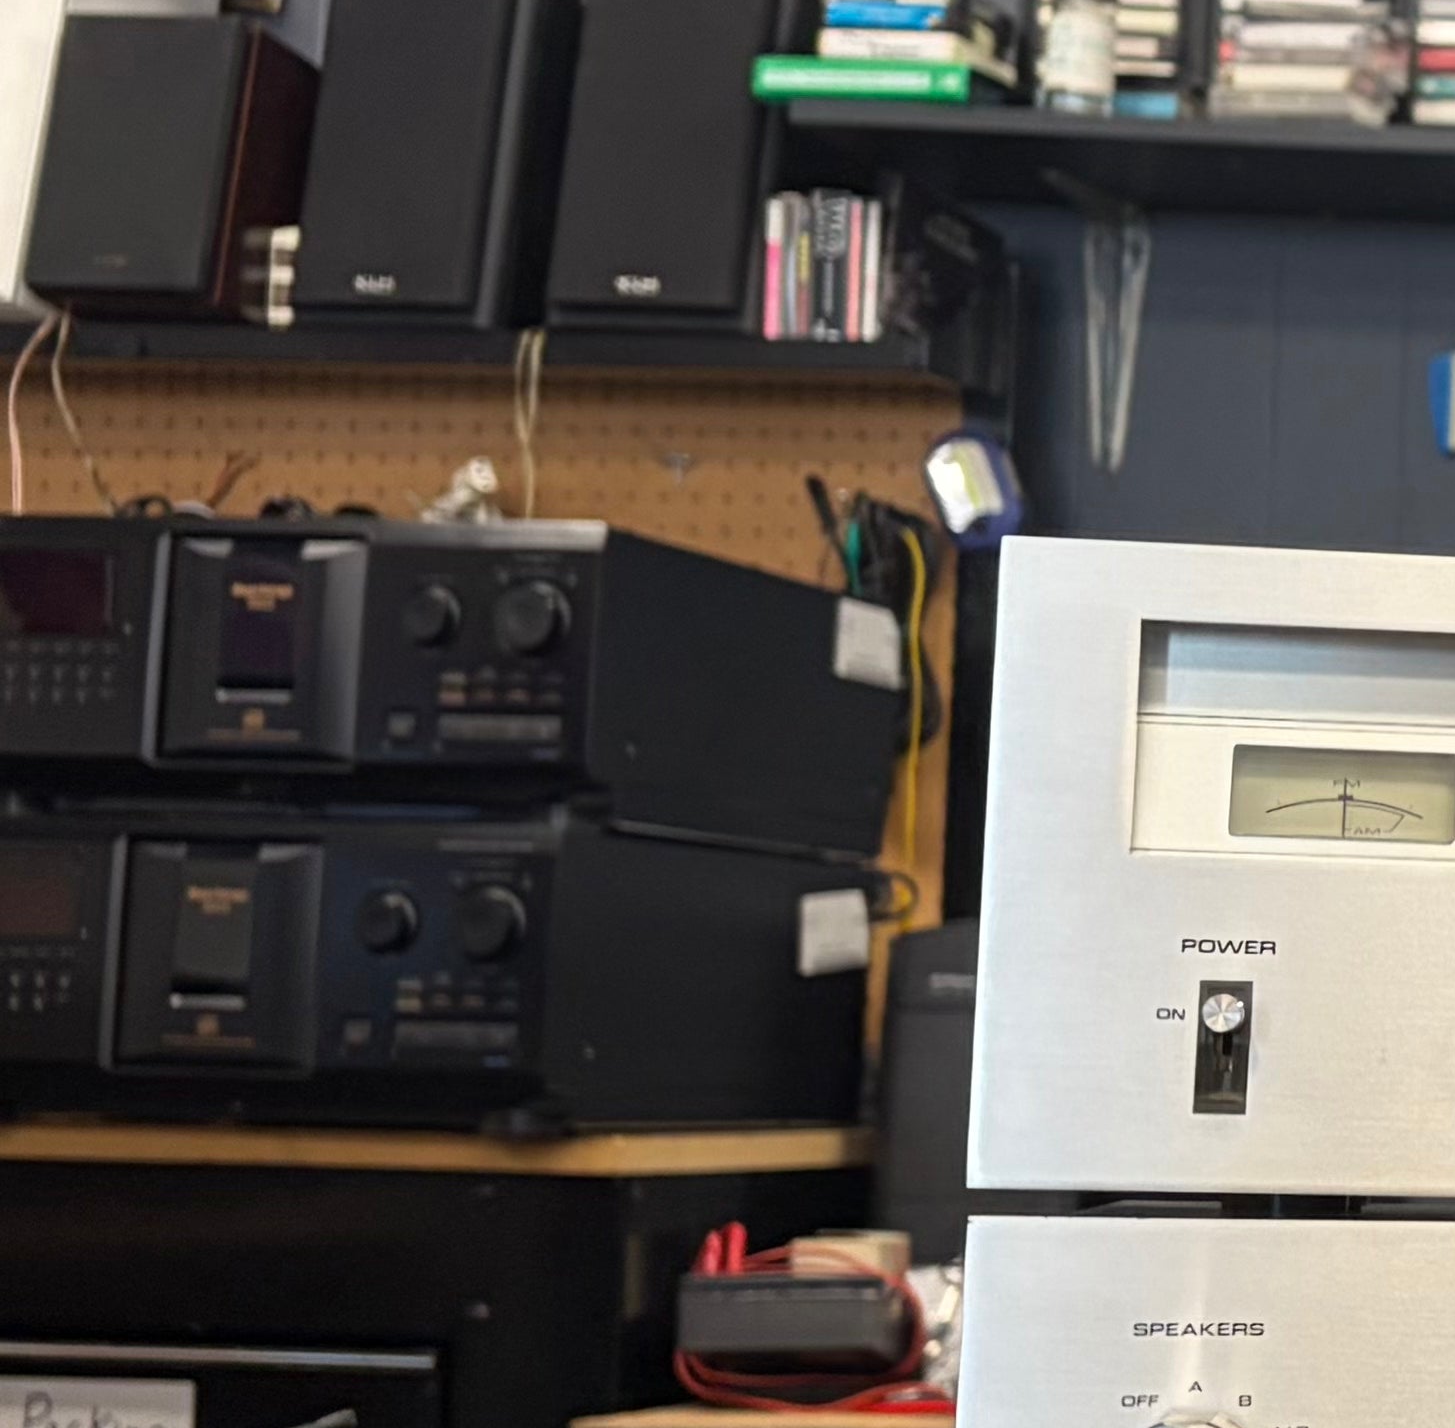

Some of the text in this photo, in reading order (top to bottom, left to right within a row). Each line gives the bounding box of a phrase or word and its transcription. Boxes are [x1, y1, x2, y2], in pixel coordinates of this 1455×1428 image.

[1180, 938, 1277, 955] POWER
[1156, 1007, 1186, 1021] ON
[1132, 1322, 1265, 1337] SPEAKERS
[1188, 1380, 1203, 1393] A
[1121, 1394, 1159, 1408] OFF
[1238, 1394, 1252, 1408] B
